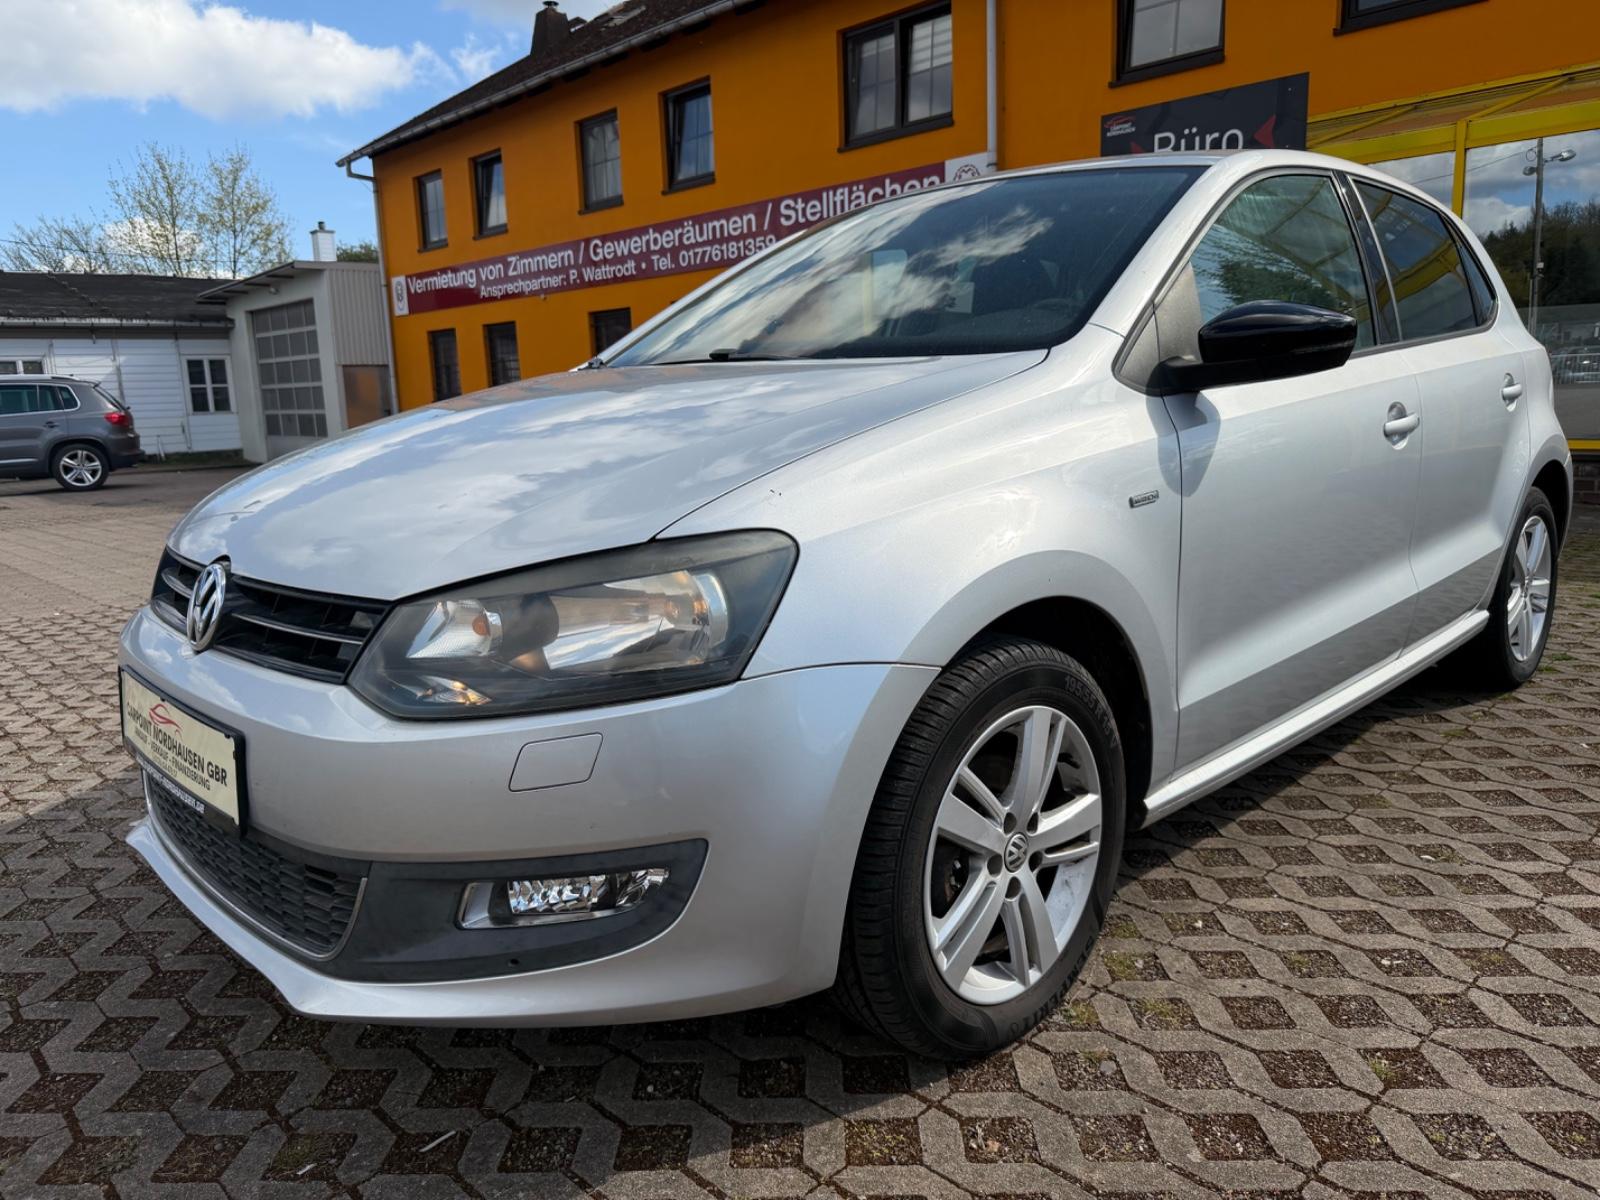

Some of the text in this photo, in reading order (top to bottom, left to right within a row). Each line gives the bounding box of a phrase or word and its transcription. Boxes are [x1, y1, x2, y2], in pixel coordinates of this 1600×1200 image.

[408, 268, 477, 294] Vermietung
[479, 263, 504, 281] von
[507, 249, 575, 277] Zimmern
[589, 213, 756, 261] Gewerberäumen
[480, 274, 567, 299] Ansprechpartner:
[569, 269, 580, 284] P.
[582, 259, 636, 282] Wattrodt
[651, 253, 675, 271] Tel.
[153, 725, 205, 774] NORDHAUSEN
[207, 761, 227, 787] GBR
